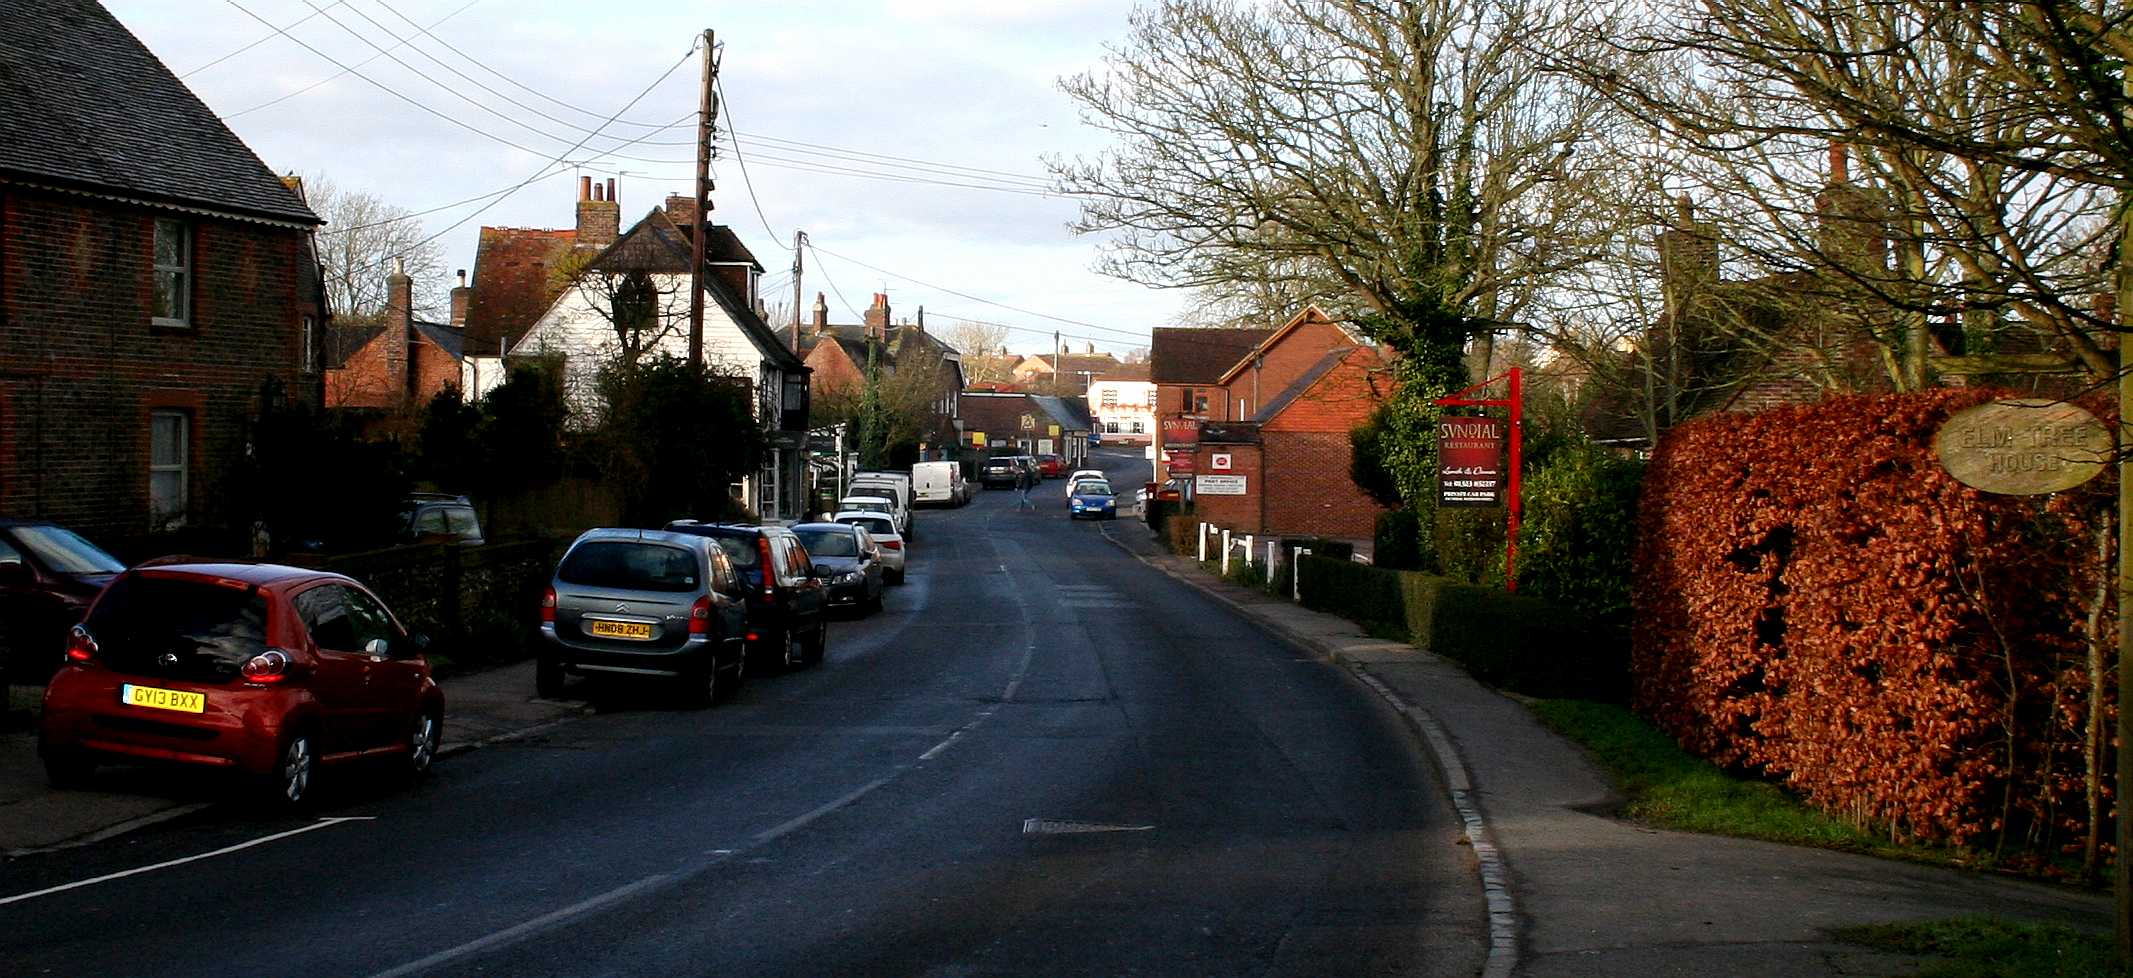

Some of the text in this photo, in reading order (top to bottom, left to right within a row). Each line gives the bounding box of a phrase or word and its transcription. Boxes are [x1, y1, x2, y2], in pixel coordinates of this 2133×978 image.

[1444, 441, 1495, 449] RESTAURANT
[1961, 425, 2089, 448] ELM TREE
[1990, 452, 2060, 472] HOUSE
[135, 689, 198, 709] GY13 BXX
